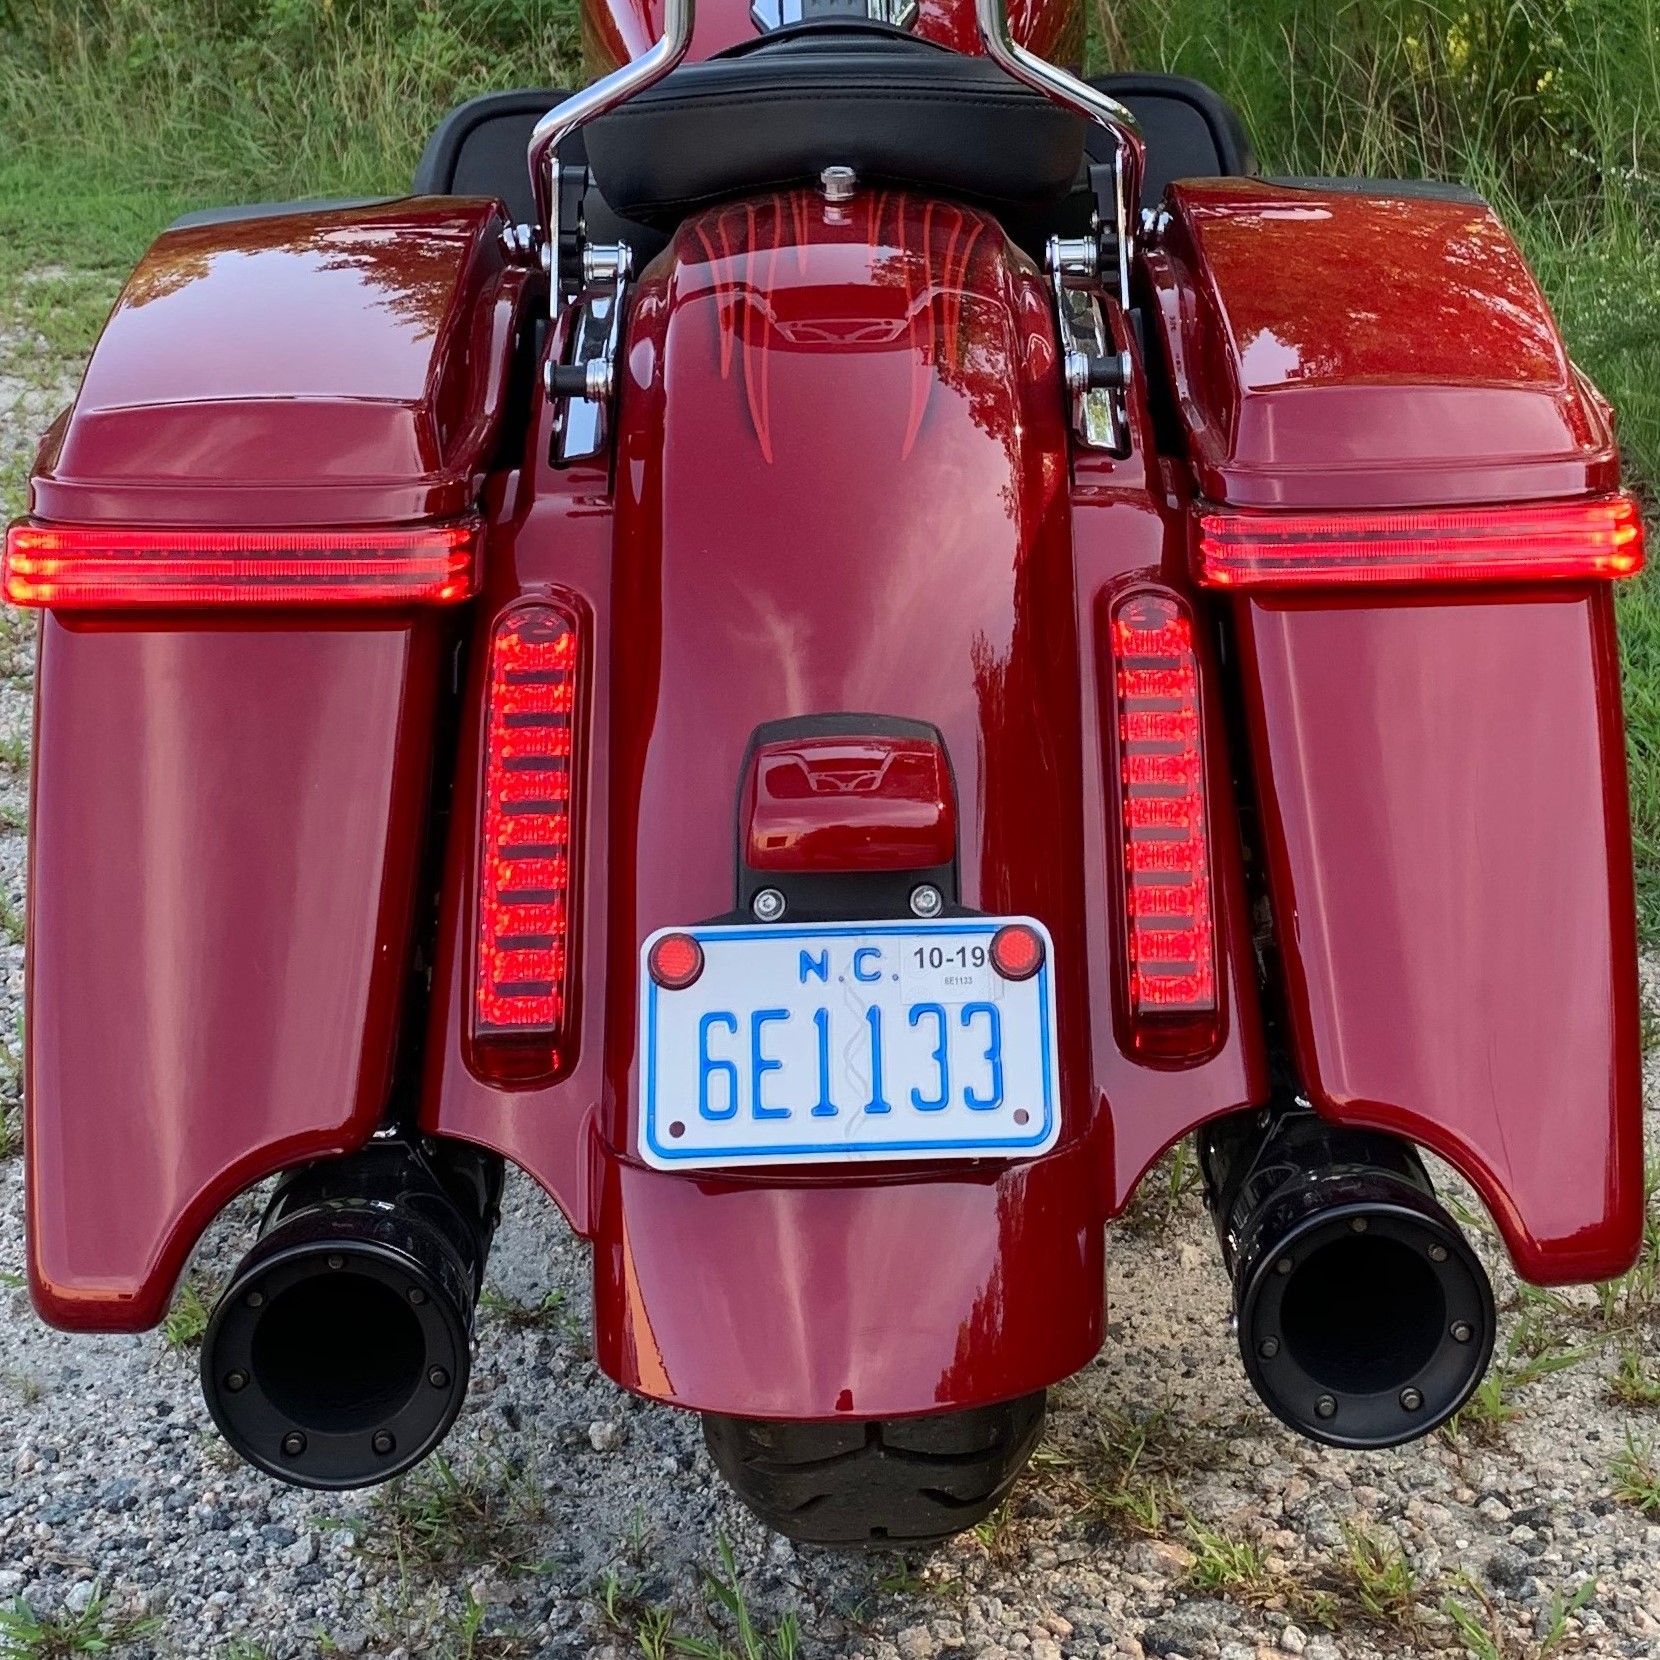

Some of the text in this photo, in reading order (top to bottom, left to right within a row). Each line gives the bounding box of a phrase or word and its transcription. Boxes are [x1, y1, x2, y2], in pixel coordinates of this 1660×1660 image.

[914, 946, 985, 969] 10-19
[944, 976, 973, 985] 6E1133
[698, 1002, 1004, 1120] 6E1133
